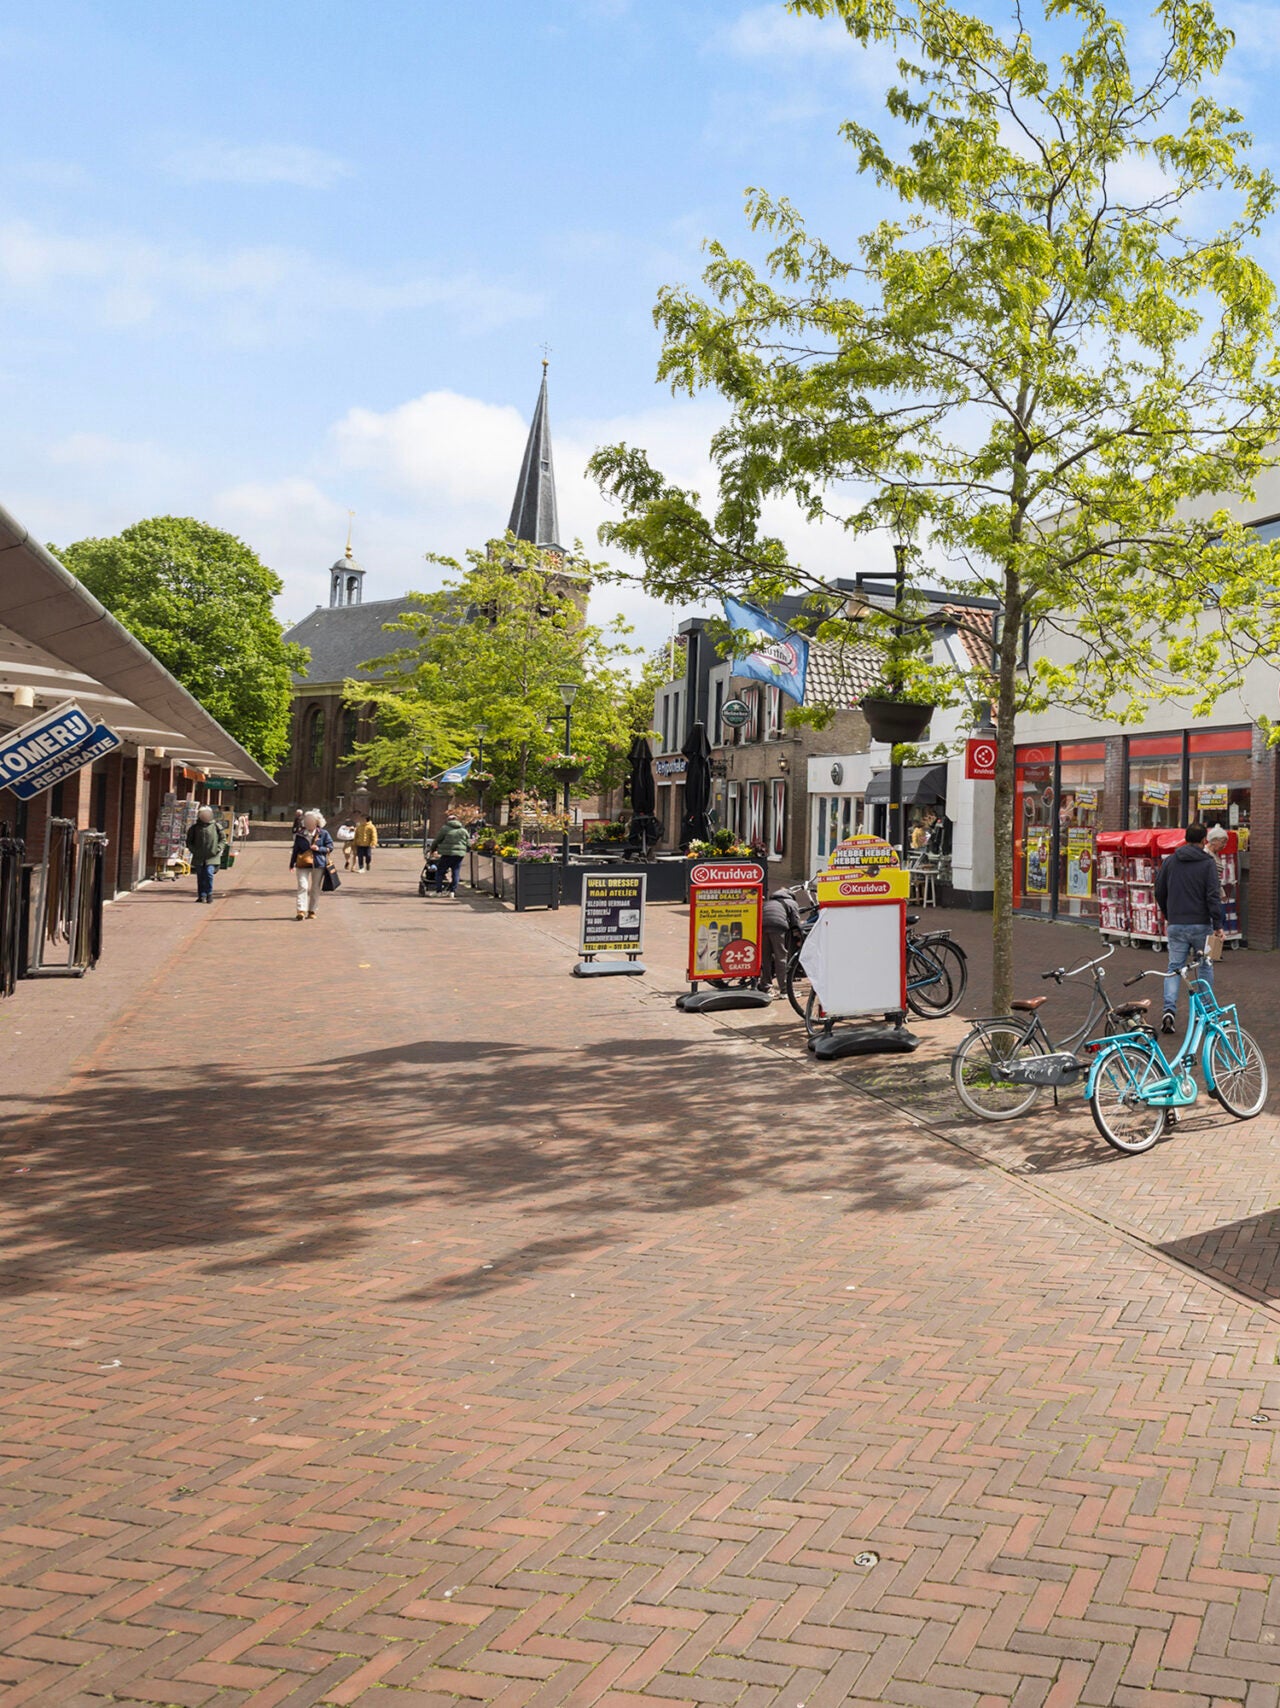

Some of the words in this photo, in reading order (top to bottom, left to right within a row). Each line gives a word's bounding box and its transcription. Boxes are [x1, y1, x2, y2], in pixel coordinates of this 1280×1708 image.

[31, 737, 115, 789] REPARATIE
[837, 849, 864, 857] HEBBE
[864, 848, 891, 857] HEBBE
[834, 857, 860, 865] HEBBE
[861, 856, 890, 864] WEKEN
[709, 868, 759, 880] Kruidvat
[588, 879, 606, 888] WELL
[608, 878, 639, 888] DRESSED
[609, 889, 638, 897] ATELIER
[852, 884, 887, 893] Kruidvat
[725, 945, 756, 963] 2+3
